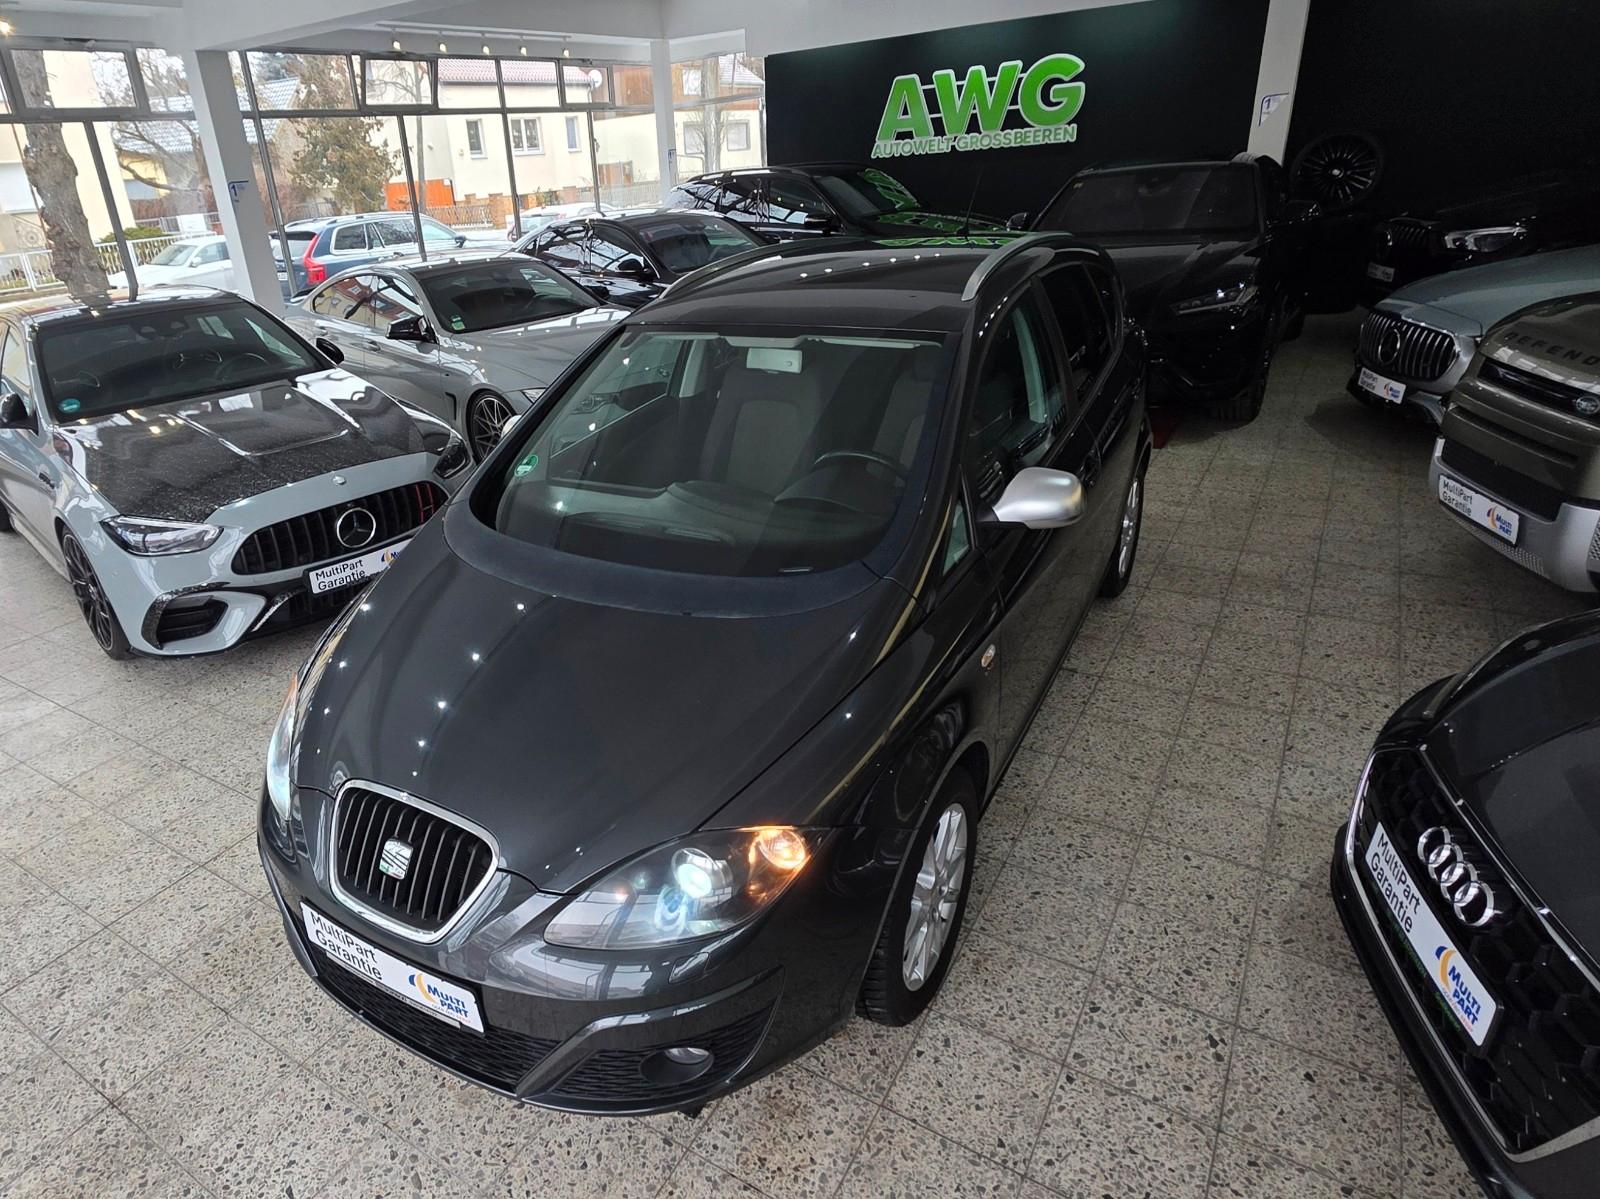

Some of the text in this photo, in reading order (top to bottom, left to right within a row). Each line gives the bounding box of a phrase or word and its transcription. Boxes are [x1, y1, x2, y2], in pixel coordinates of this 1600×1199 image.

[876, 53, 1085, 142] AWG
[871, 126, 1077, 158] AUTOWELT GROSSBEEREN
[1443, 480, 1473, 504] MultiPart
[1443, 491, 1472, 517] Garantie
[315, 559, 364, 581] MultiPart
[318, 571, 366, 591] Garantie
[1377, 832, 1421, 915] MultiPart
[1371, 852, 1413, 934] Garantie
[310, 911, 378, 964] MultiPart
[315, 930, 383, 981] Garantie
[427, 984, 466, 1009] MULTI
[1448, 965, 1481, 1014] MULTI
[440, 999, 469, 1018] PART
[1452, 989, 1479, 1026] PART
